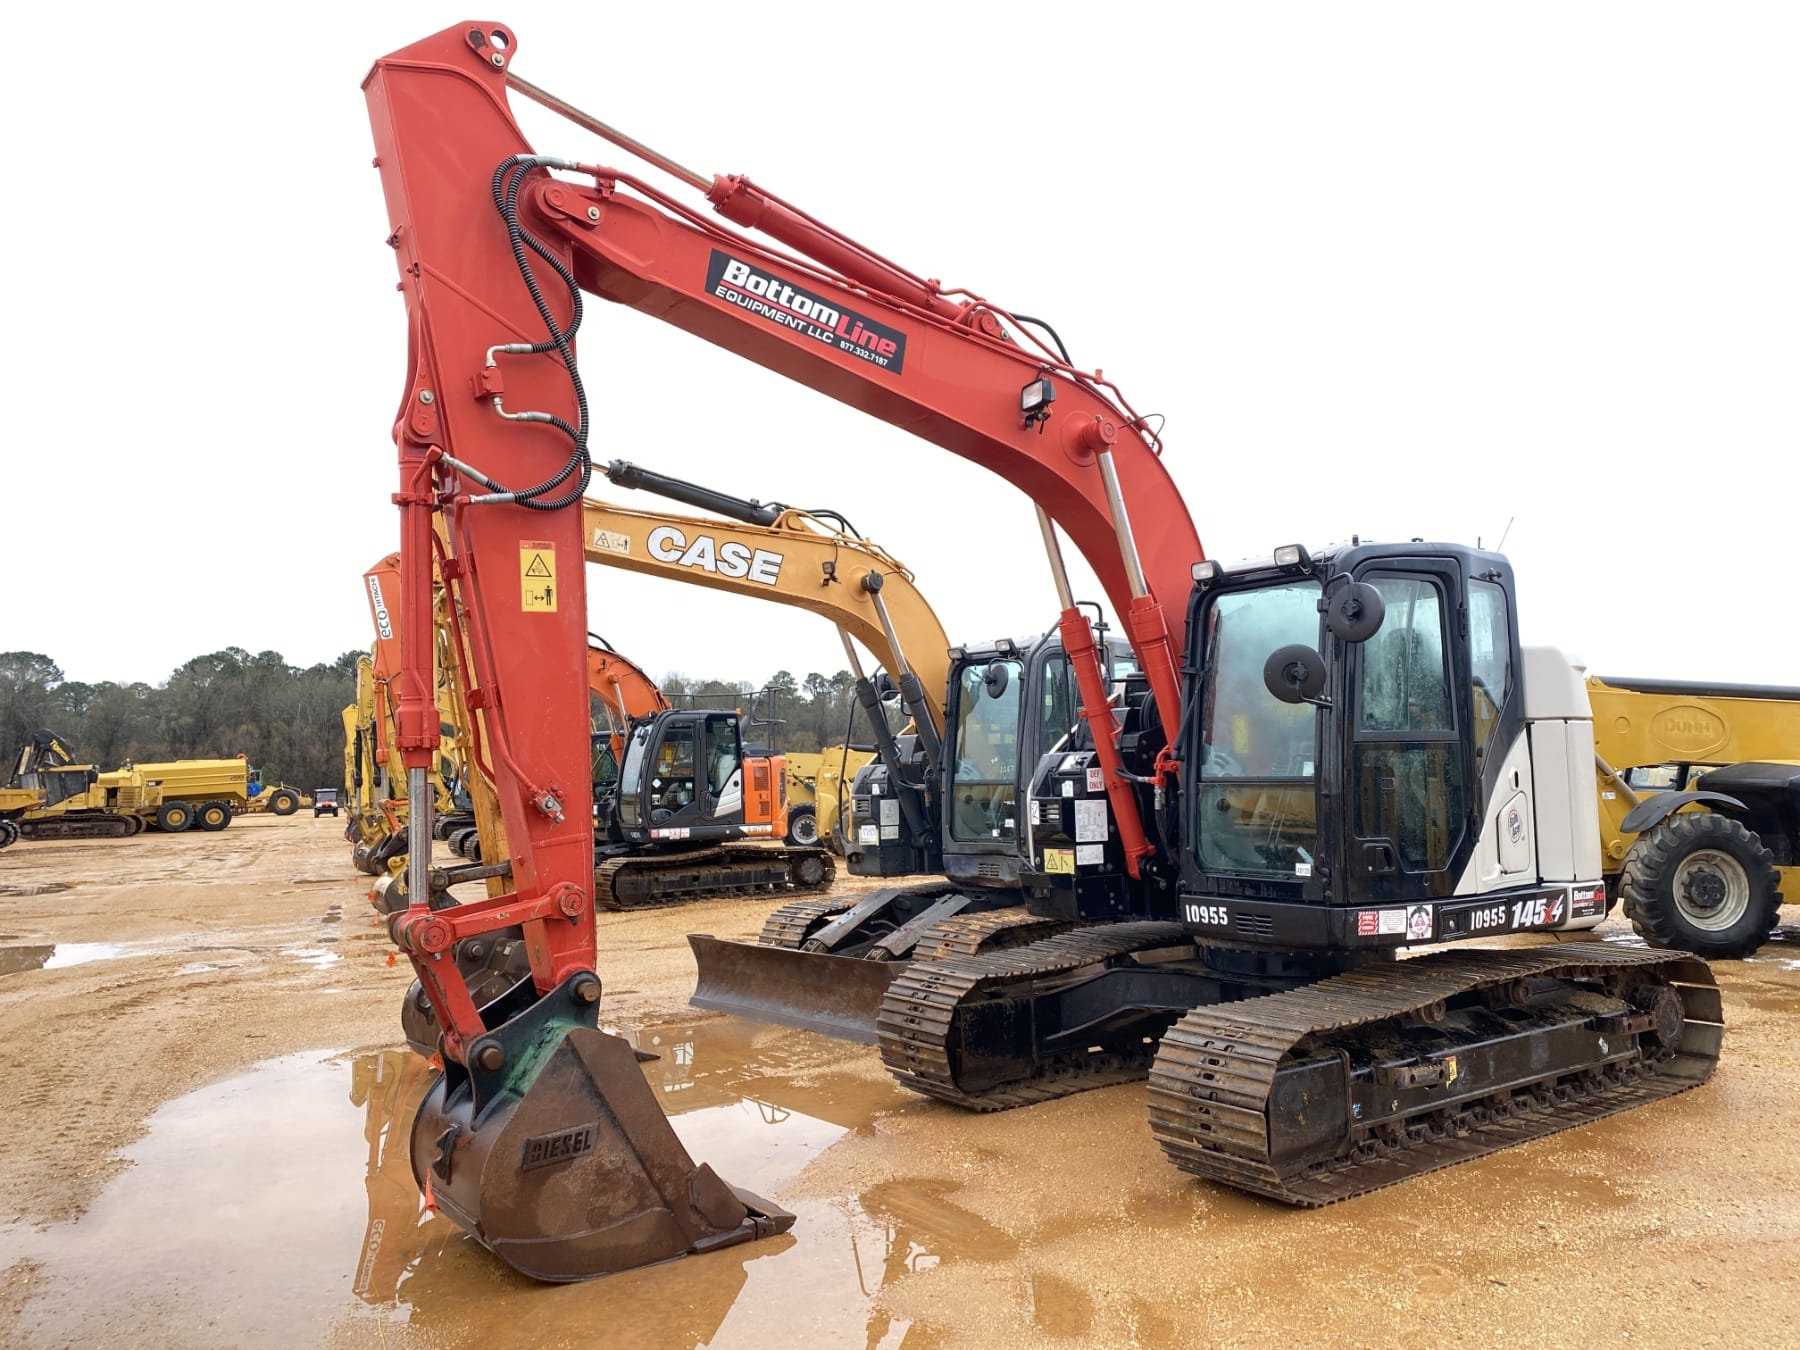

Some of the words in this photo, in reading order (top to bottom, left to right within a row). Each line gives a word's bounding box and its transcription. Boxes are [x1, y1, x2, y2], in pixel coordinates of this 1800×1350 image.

[715, 286, 807, 334] EQUIPMENT
[808, 323, 834, 343] LLC
[840, 340, 888, 367] 877.332.7187
[647, 526, 783, 585] CASE
[371, 577, 382, 608] HITACHI
[1185, 904, 1228, 925] 10955
[1470, 905, 1505, 930] 10955
